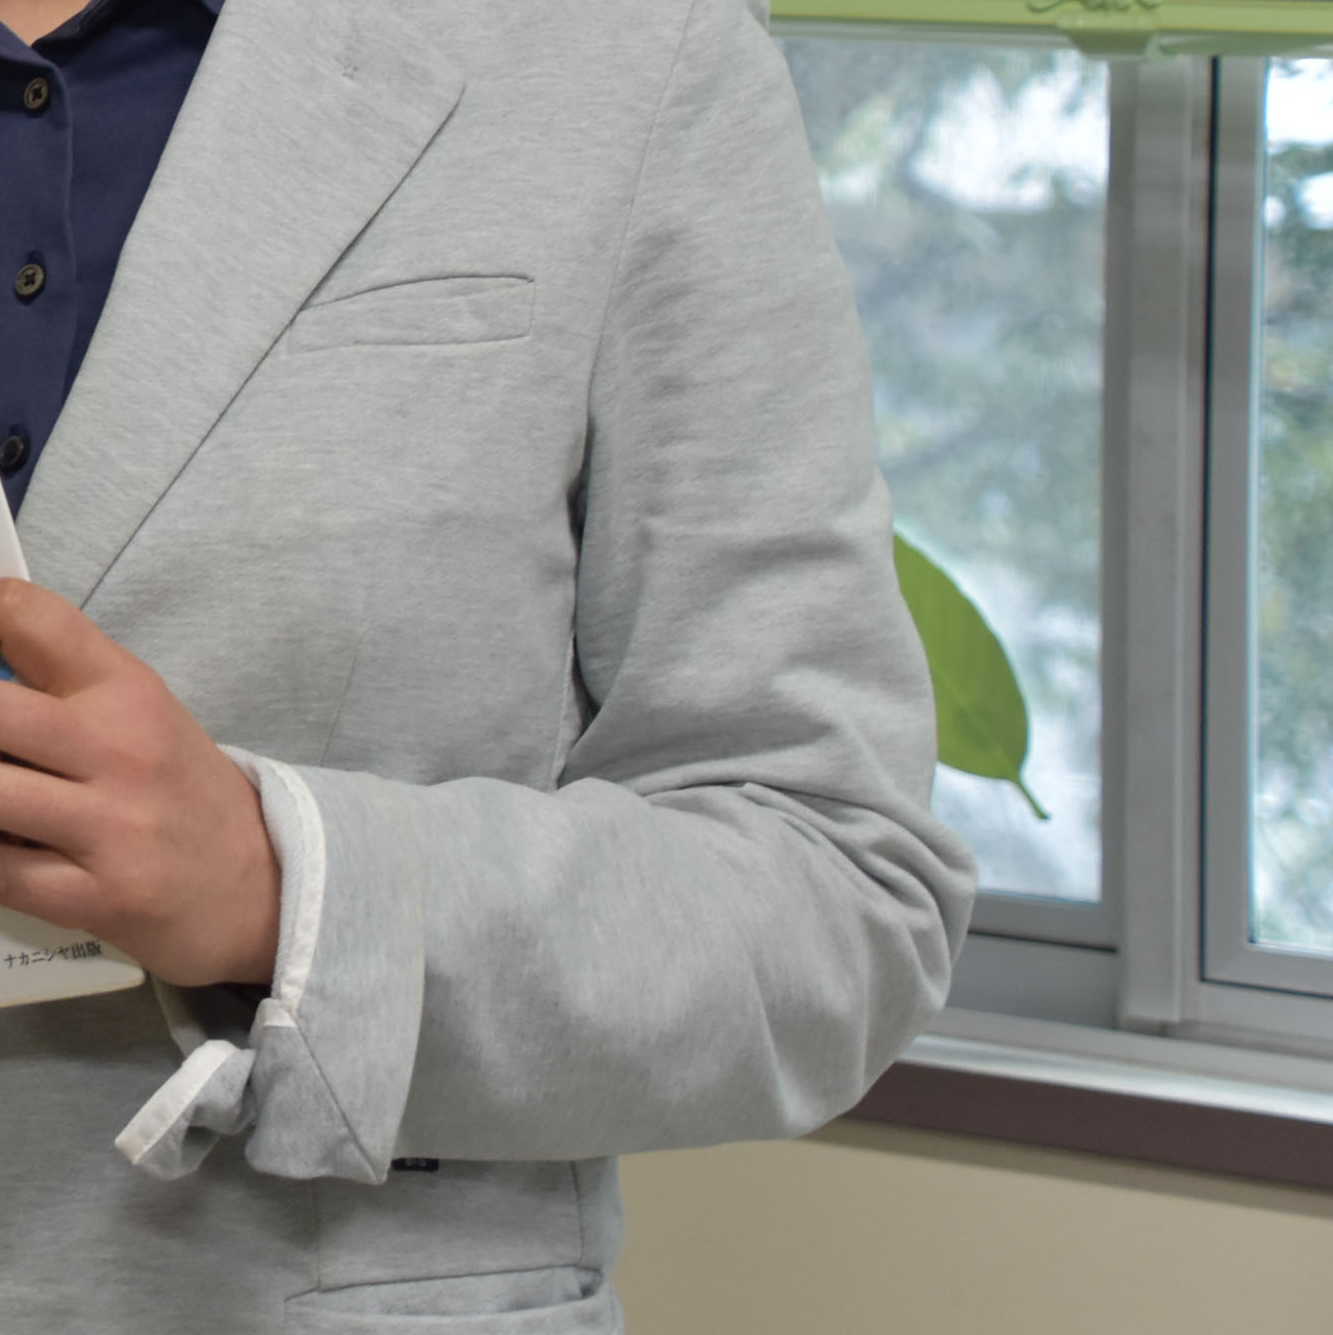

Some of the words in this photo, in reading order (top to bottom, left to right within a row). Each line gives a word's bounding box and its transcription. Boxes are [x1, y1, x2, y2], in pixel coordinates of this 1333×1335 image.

[3, 941, 103, 968] ナカニシヤ出版
